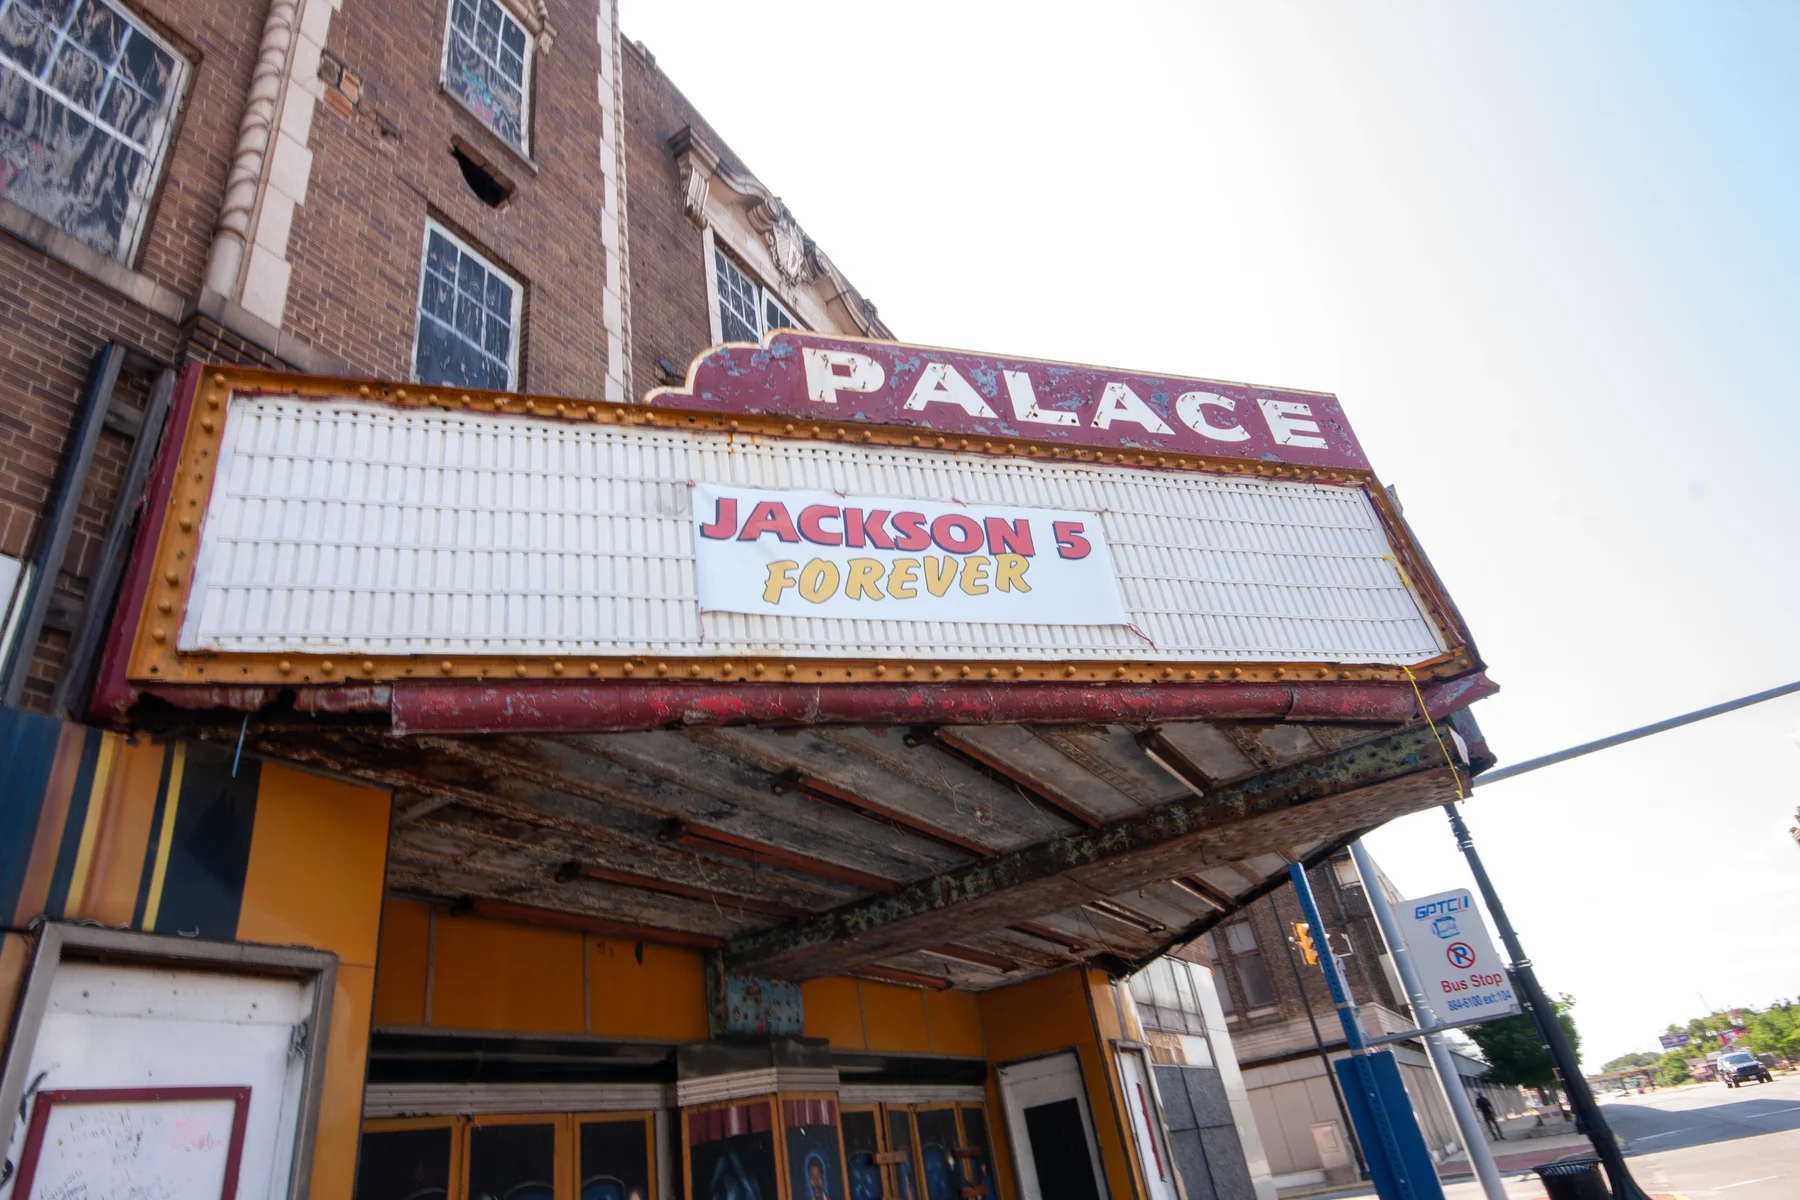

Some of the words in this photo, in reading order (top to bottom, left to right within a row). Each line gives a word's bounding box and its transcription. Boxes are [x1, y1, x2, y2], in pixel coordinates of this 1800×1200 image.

[801, 347, 1329, 450] PALACE
[700, 497, 1036, 558] JACKSON
[1052, 521, 1091, 559] 5
[762, 554, 1032, 605] FOREVER
[1440, 979, 1468, 993] Bus
[1469, 973, 1503, 987] Stop
